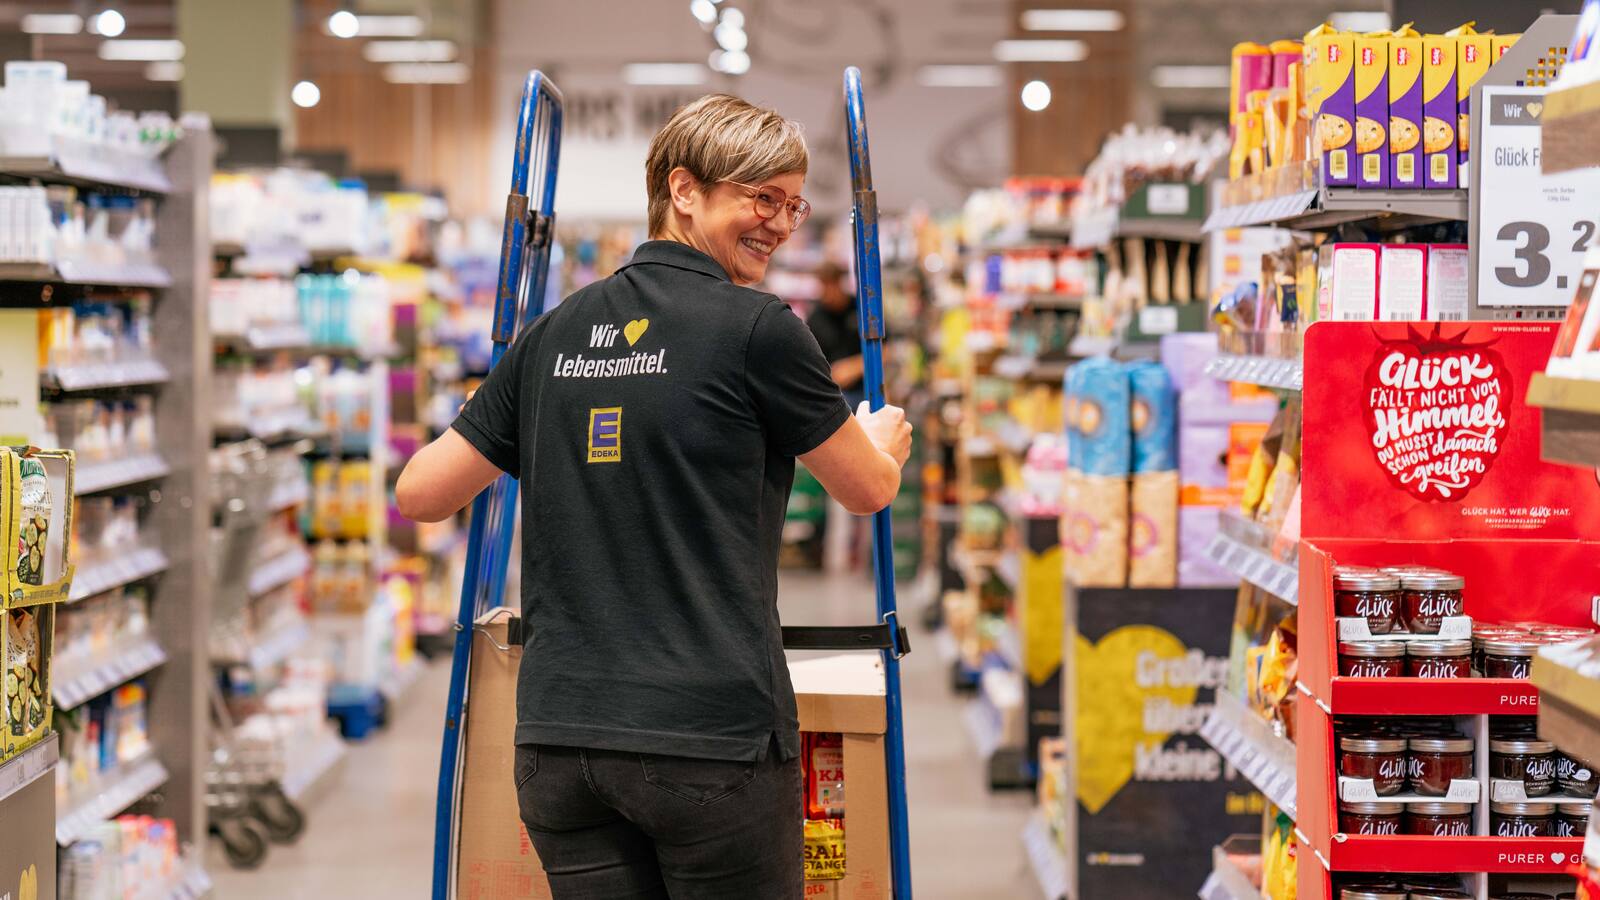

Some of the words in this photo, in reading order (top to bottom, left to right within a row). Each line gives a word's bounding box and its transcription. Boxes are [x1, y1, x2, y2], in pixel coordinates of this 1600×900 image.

[1503, 103, 1522, 118] Wir
[1494, 146, 1529, 167] Glück
[589, 323, 620, 348] Wir
[553, 348, 668, 378] Lebensmittel.
[1379, 352, 1494, 390] GLÜCK
[1369, 386, 1415, 408] FÄLLT
[1420, 387, 1467, 407] NICHT
[1470, 377, 1501, 401] VOM
[1372, 394, 1506, 448] Himmel,
[1377, 445, 1395, 464] DU
[1394, 432, 1435, 455] MUSST
[1431, 426, 1498, 457] danach
[591, 449, 620, 458] EDEKA
[1400, 452, 1486, 493] greifen
[1509, 507, 1527, 516] WER
[1355, 596, 1393, 617] GLÜCK
[1418, 595, 1458, 617] GLÜCK
[1500, 695, 1539, 706] PURE
[803, 844, 847, 860] SAL
[1498, 853, 1545, 864] PURER
